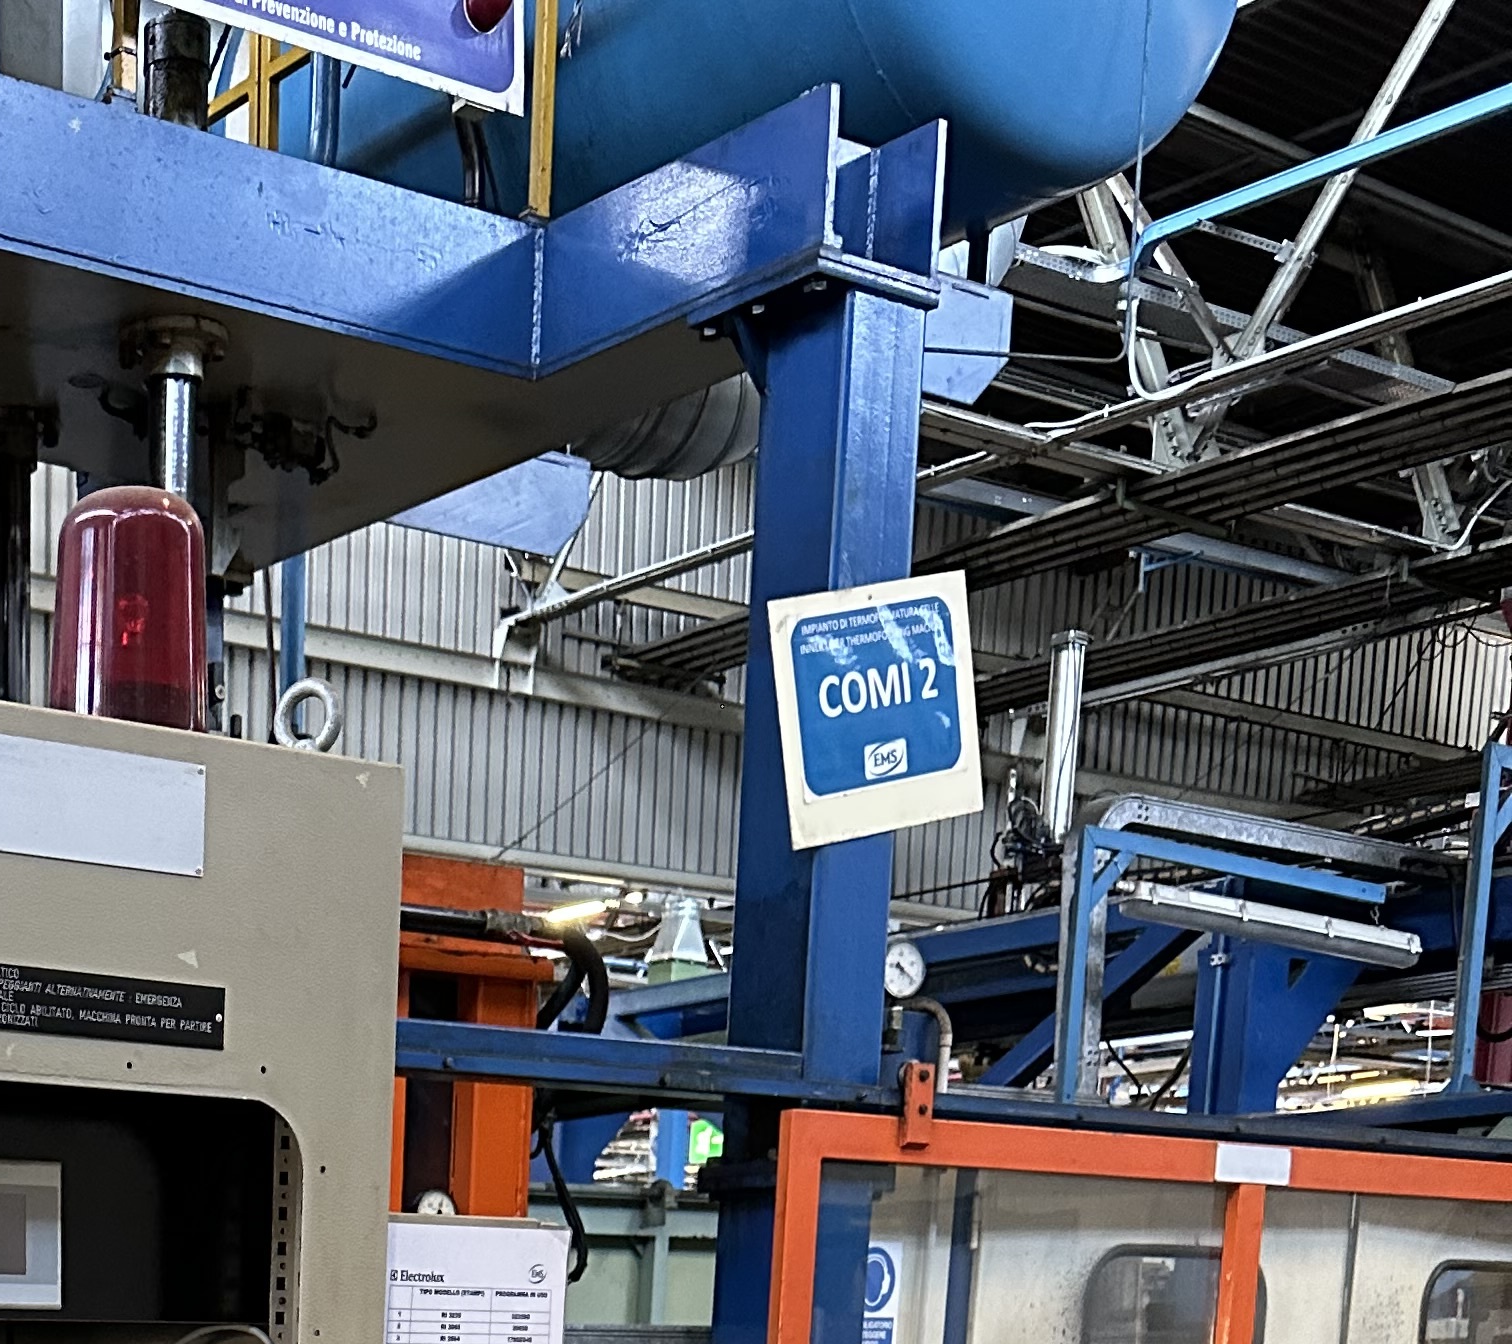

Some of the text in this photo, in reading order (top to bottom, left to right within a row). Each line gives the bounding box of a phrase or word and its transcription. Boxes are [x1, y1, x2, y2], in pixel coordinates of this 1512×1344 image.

[338, 22, 347, 38] e
[350, 21, 422, 61] Protezione
[801, 619, 838, 635] IMPIANTO
[840, 617, 848, 630] DI
[819, 657, 938, 719] COMI 2
[873, 748, 898, 767] EMS
[1, 1000, 26, 1014] CICLO
[79, 1009, 121, 1024] MACCHINA
[125, 1013, 157, 1028] PRONTA
[160, 1016, 176, 1030] PER
[179, 1020, 212, 1034] PARTIRE
[400, 1269, 445, 1283] Electrolux
